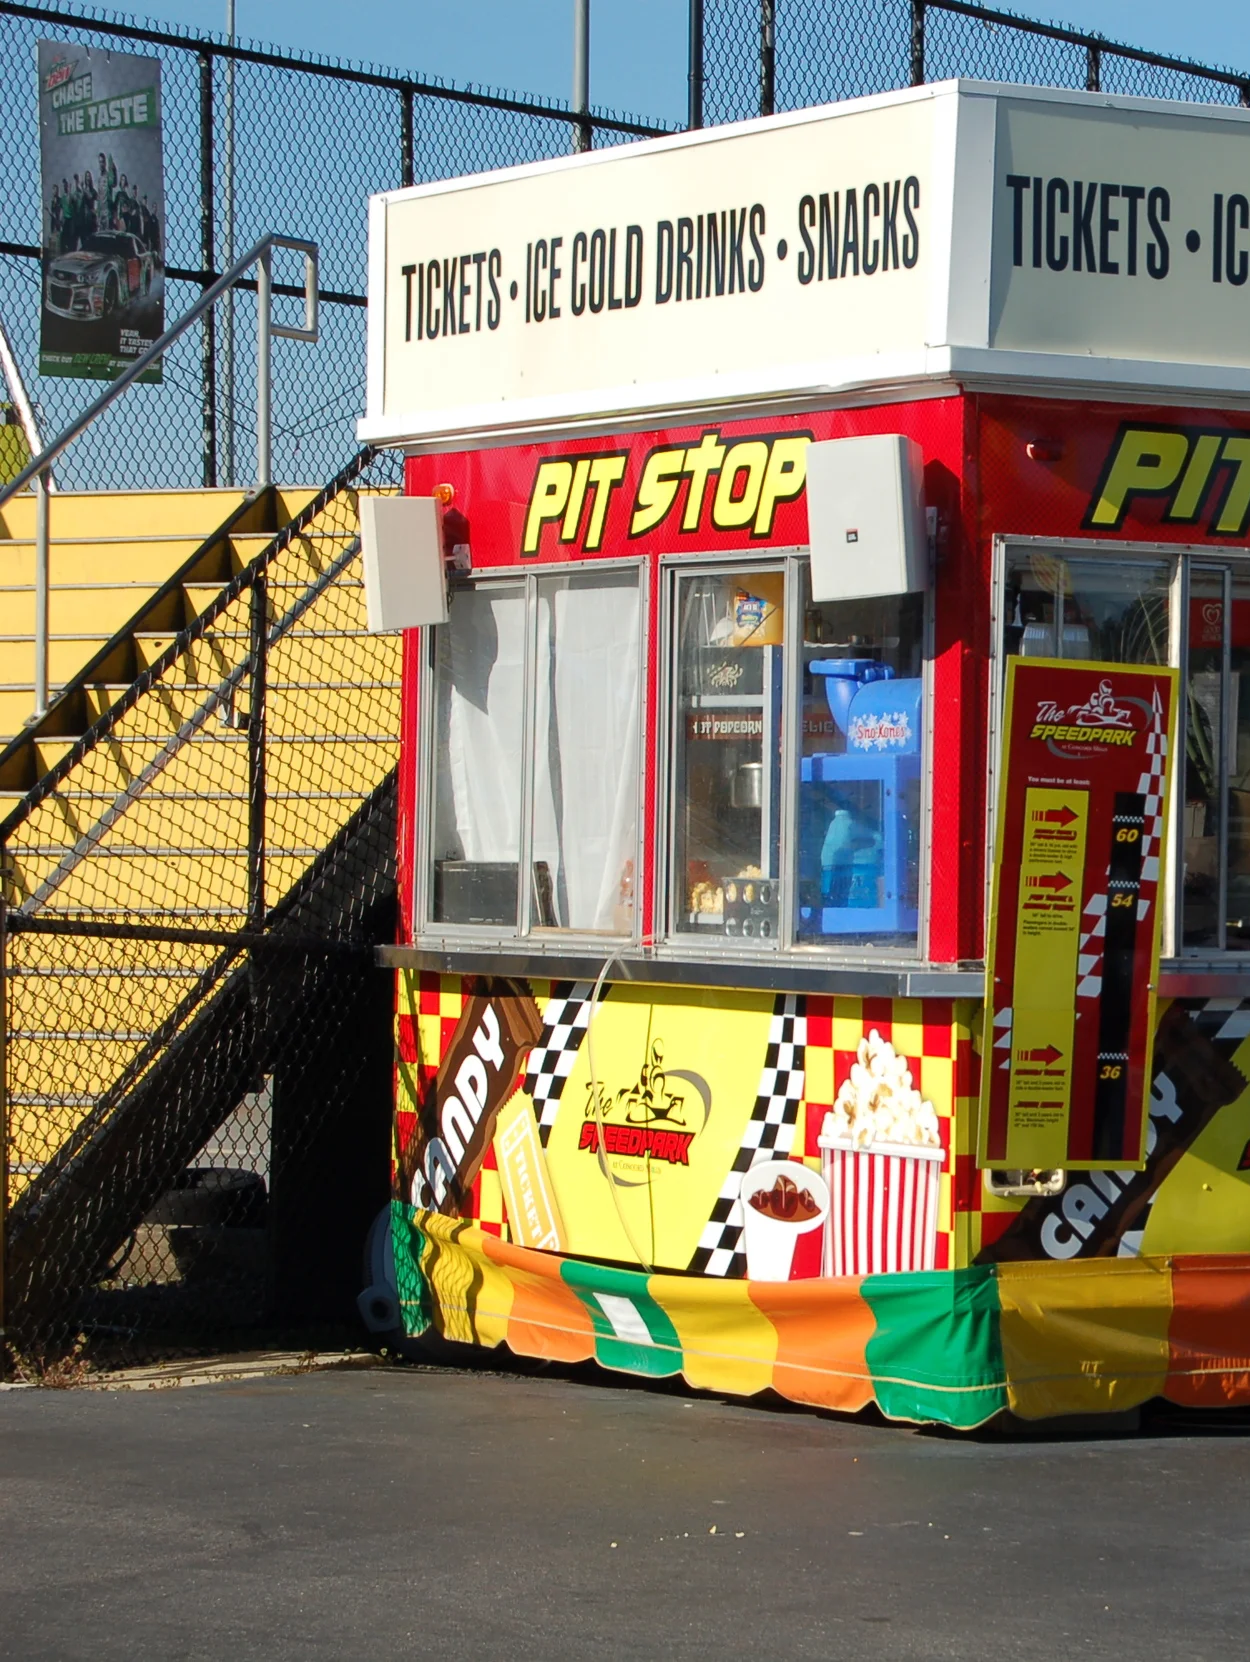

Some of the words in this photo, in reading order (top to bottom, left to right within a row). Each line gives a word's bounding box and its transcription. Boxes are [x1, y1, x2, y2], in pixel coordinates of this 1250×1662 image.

[52, 75, 92, 109] CHASE
[60, 109, 84, 134] THE
[88, 94, 148, 129] TASTE
[1006, 174, 1171, 280] TICKETS
[401, 247, 501, 342] TICKETS
[525, 236, 563, 324] ICE
[571, 223, 643, 317] COLD
[655, 203, 765, 306] DRINKS
[798, 175, 920, 285] SNACKS
[521, 453, 629, 555] PIT
[714, 720, 761, 735] POPCORN
[1036, 701, 1065, 723] The
[1029, 724, 1137, 747] SPEEDPARK
[1116, 828, 1139, 842] 60
[1111, 893, 1133, 907] 54
[1100, 1065, 1121, 1079] 36
[411, 1003, 504, 1213] CANDY
[584, 1080, 613, 1118] The
[578, 1120, 696, 1167] SPEEDPARK
[1041, 1072, 1183, 1259] CAY
[515, 1144, 542, 1239] TICKET
